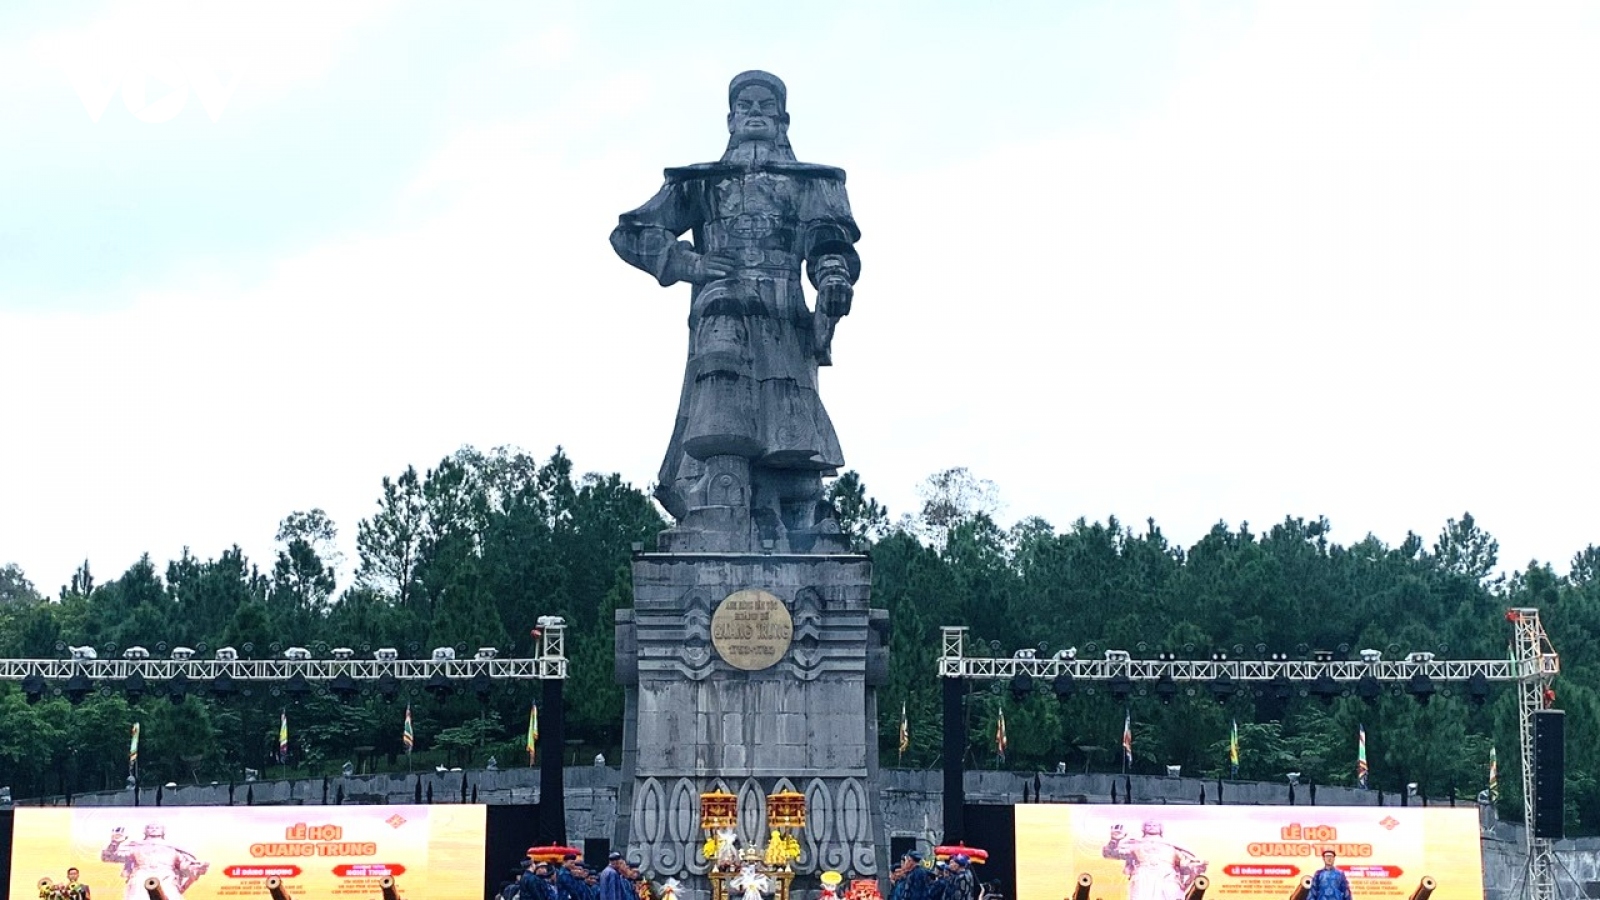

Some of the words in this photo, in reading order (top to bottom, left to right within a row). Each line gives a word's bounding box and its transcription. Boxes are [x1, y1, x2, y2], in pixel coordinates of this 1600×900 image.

[714, 623, 752, 640] QUANG
[286, 823, 306, 840] LỄ
[308, 824, 342, 841] HỘI
[1281, 823, 1301, 840] LỄ
[1304, 825, 1337, 841] HỘI
[250, 842, 315, 858] QUANG
[316, 842, 377, 857] TRUNG
[1248, 842, 1311, 857] QUANG
